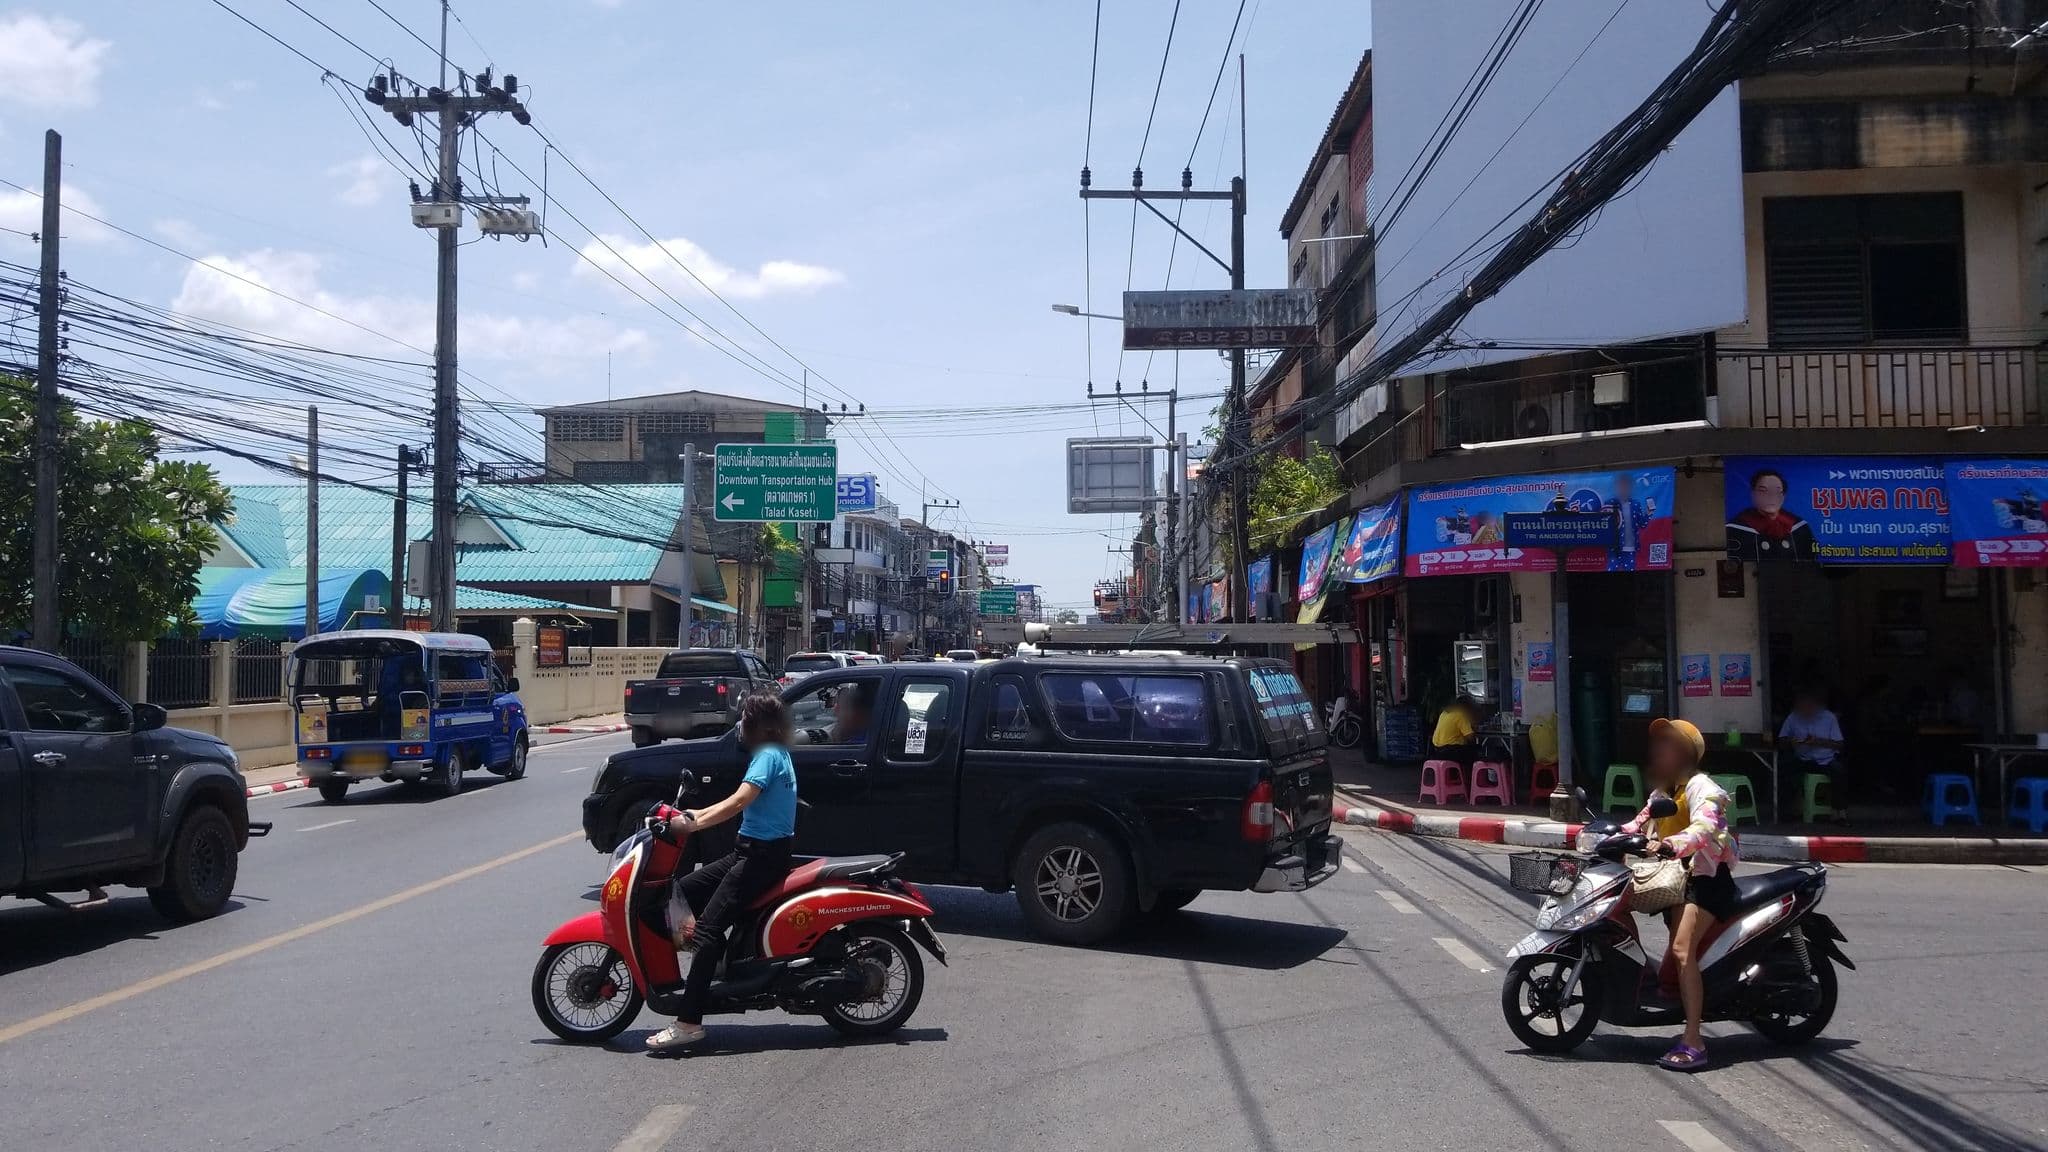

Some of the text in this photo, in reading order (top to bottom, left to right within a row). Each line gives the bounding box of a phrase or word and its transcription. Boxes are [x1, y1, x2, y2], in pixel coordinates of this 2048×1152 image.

[719, 474, 833, 487] Downtown Transportation Hub
[1812, 487, 1888, 517] ชุมพล
[761, 507, 786, 519] (Talad
[1820, 519, 1843, 534] เป็น
[1849, 522, 1882, 534] นายก
[818, 905, 865, 915] MANCHESTER
